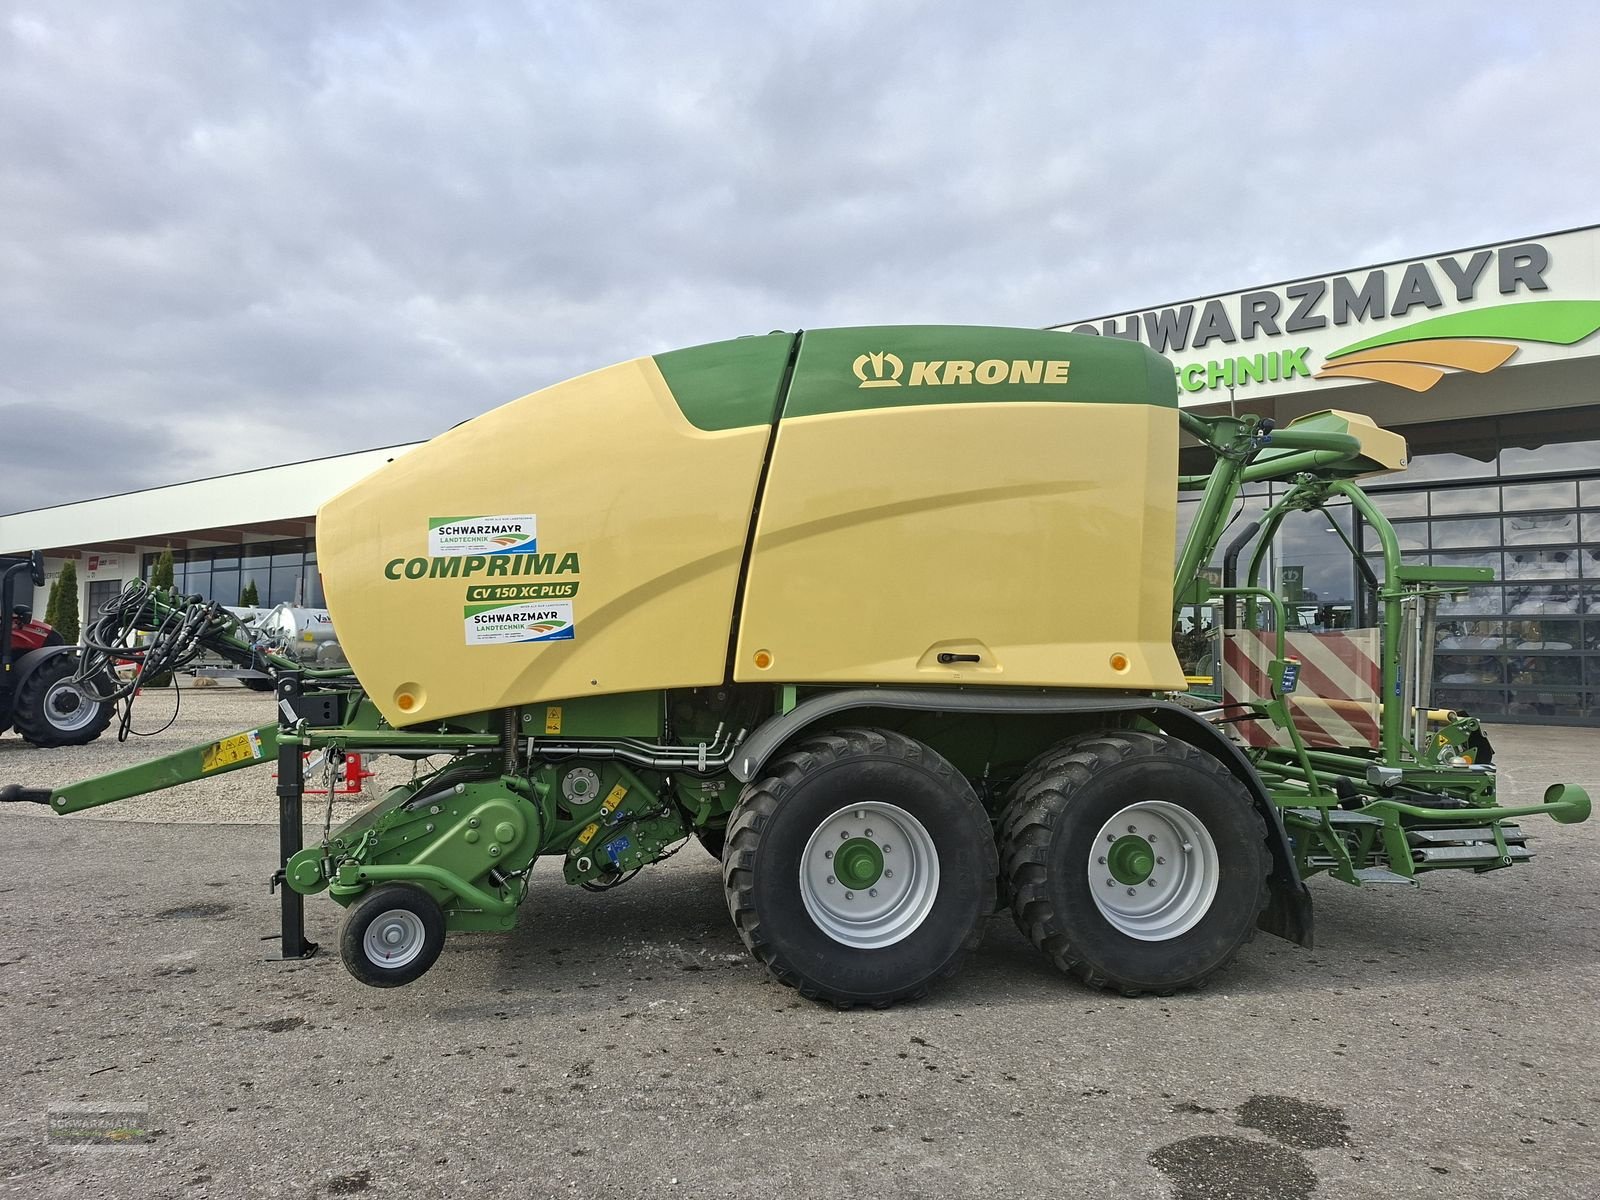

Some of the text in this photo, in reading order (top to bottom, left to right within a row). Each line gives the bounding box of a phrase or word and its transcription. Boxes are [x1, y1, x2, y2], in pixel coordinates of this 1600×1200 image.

[1071, 243, 1549, 353] HWARZMAYR
[908, 359, 1070, 386] KRONE
[1175, 346, 1310, 393] CHNIK
[438, 524, 522, 536] SCHWARZMAYR
[384, 552, 581, 580] COMPRIMA
[473, 584, 572, 599] CV 150 XC PLUS
[474, 611, 558, 624] SCHWARZMAYR
[476, 623, 525, 632] LANDTECHNIK
